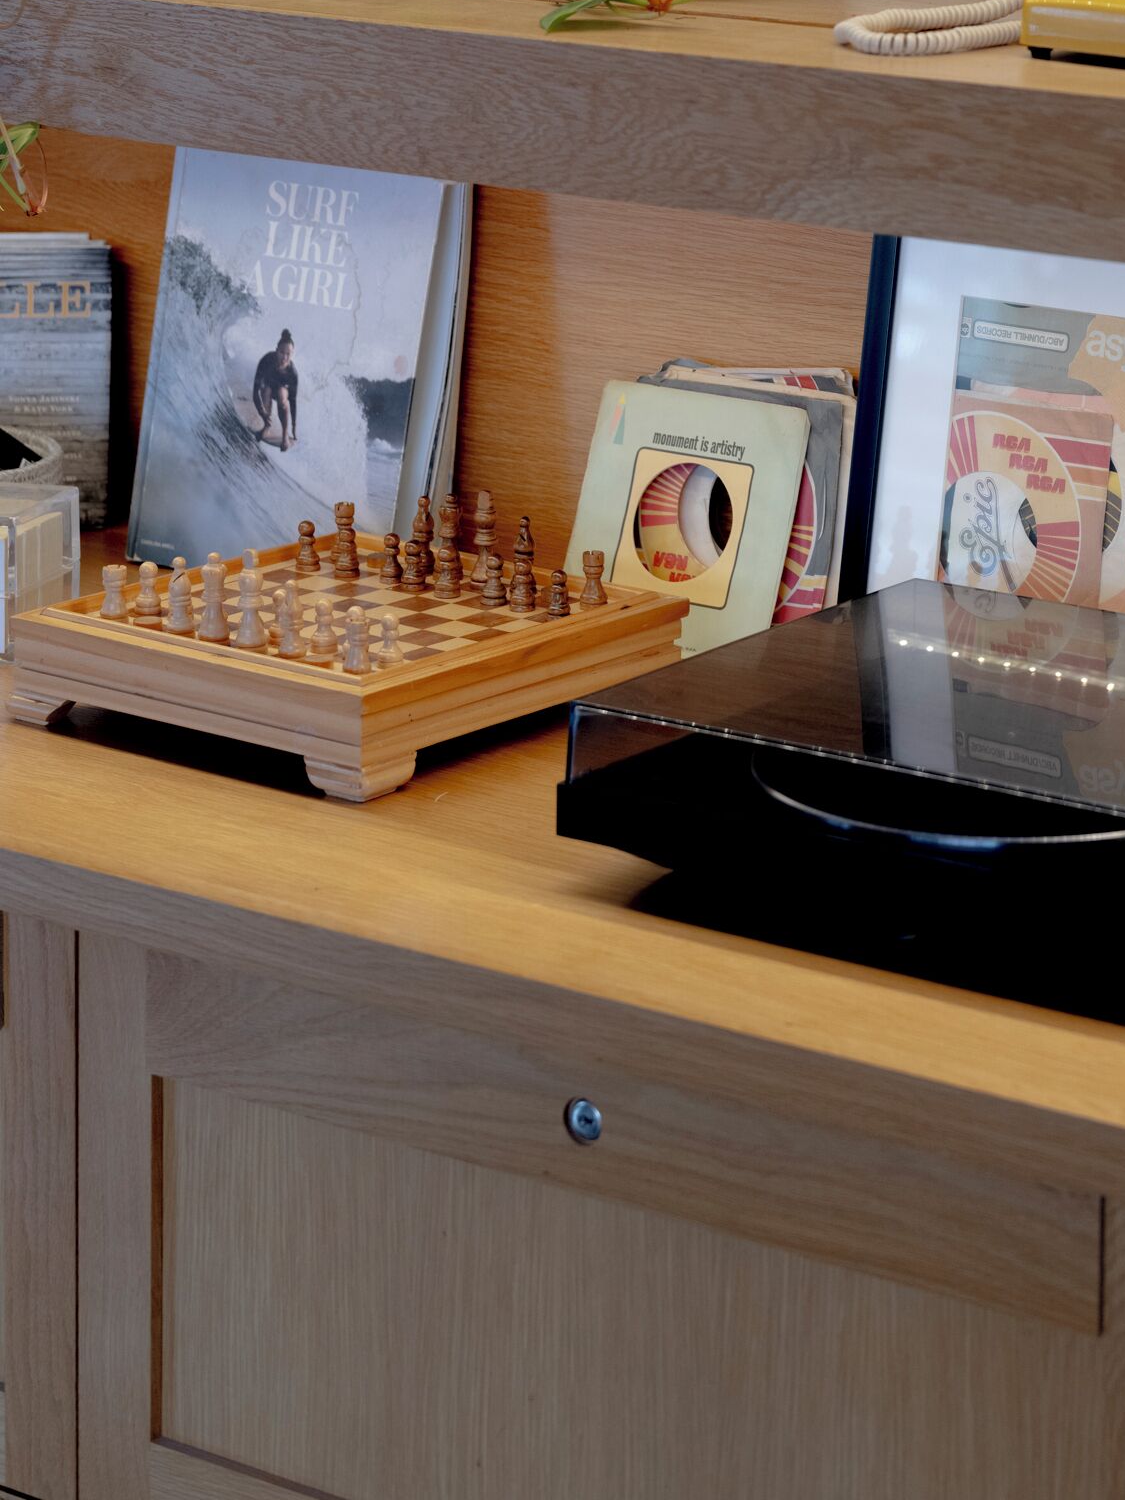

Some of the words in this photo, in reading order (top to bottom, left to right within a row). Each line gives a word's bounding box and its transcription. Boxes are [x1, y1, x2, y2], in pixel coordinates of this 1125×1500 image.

[265, 179, 360, 227] SURF
[263, 220, 350, 268] LIKE
[241, 259, 266, 298] A
[272, 262, 355, 311] GIRL
[976, 324, 1012, 339] RECORDS
[1014, 331, 1066, 347] ABC/DUNHILL
[652, 431, 700, 451] monument
[700, 436, 710, 452] is
[710, 439, 746, 462] artistry
[992, 432, 1031, 454] RCA
[1008, 453, 1049, 474] RCA
[1025, 473, 1067, 495] RCA
[959, 476, 1016, 591] Epic
